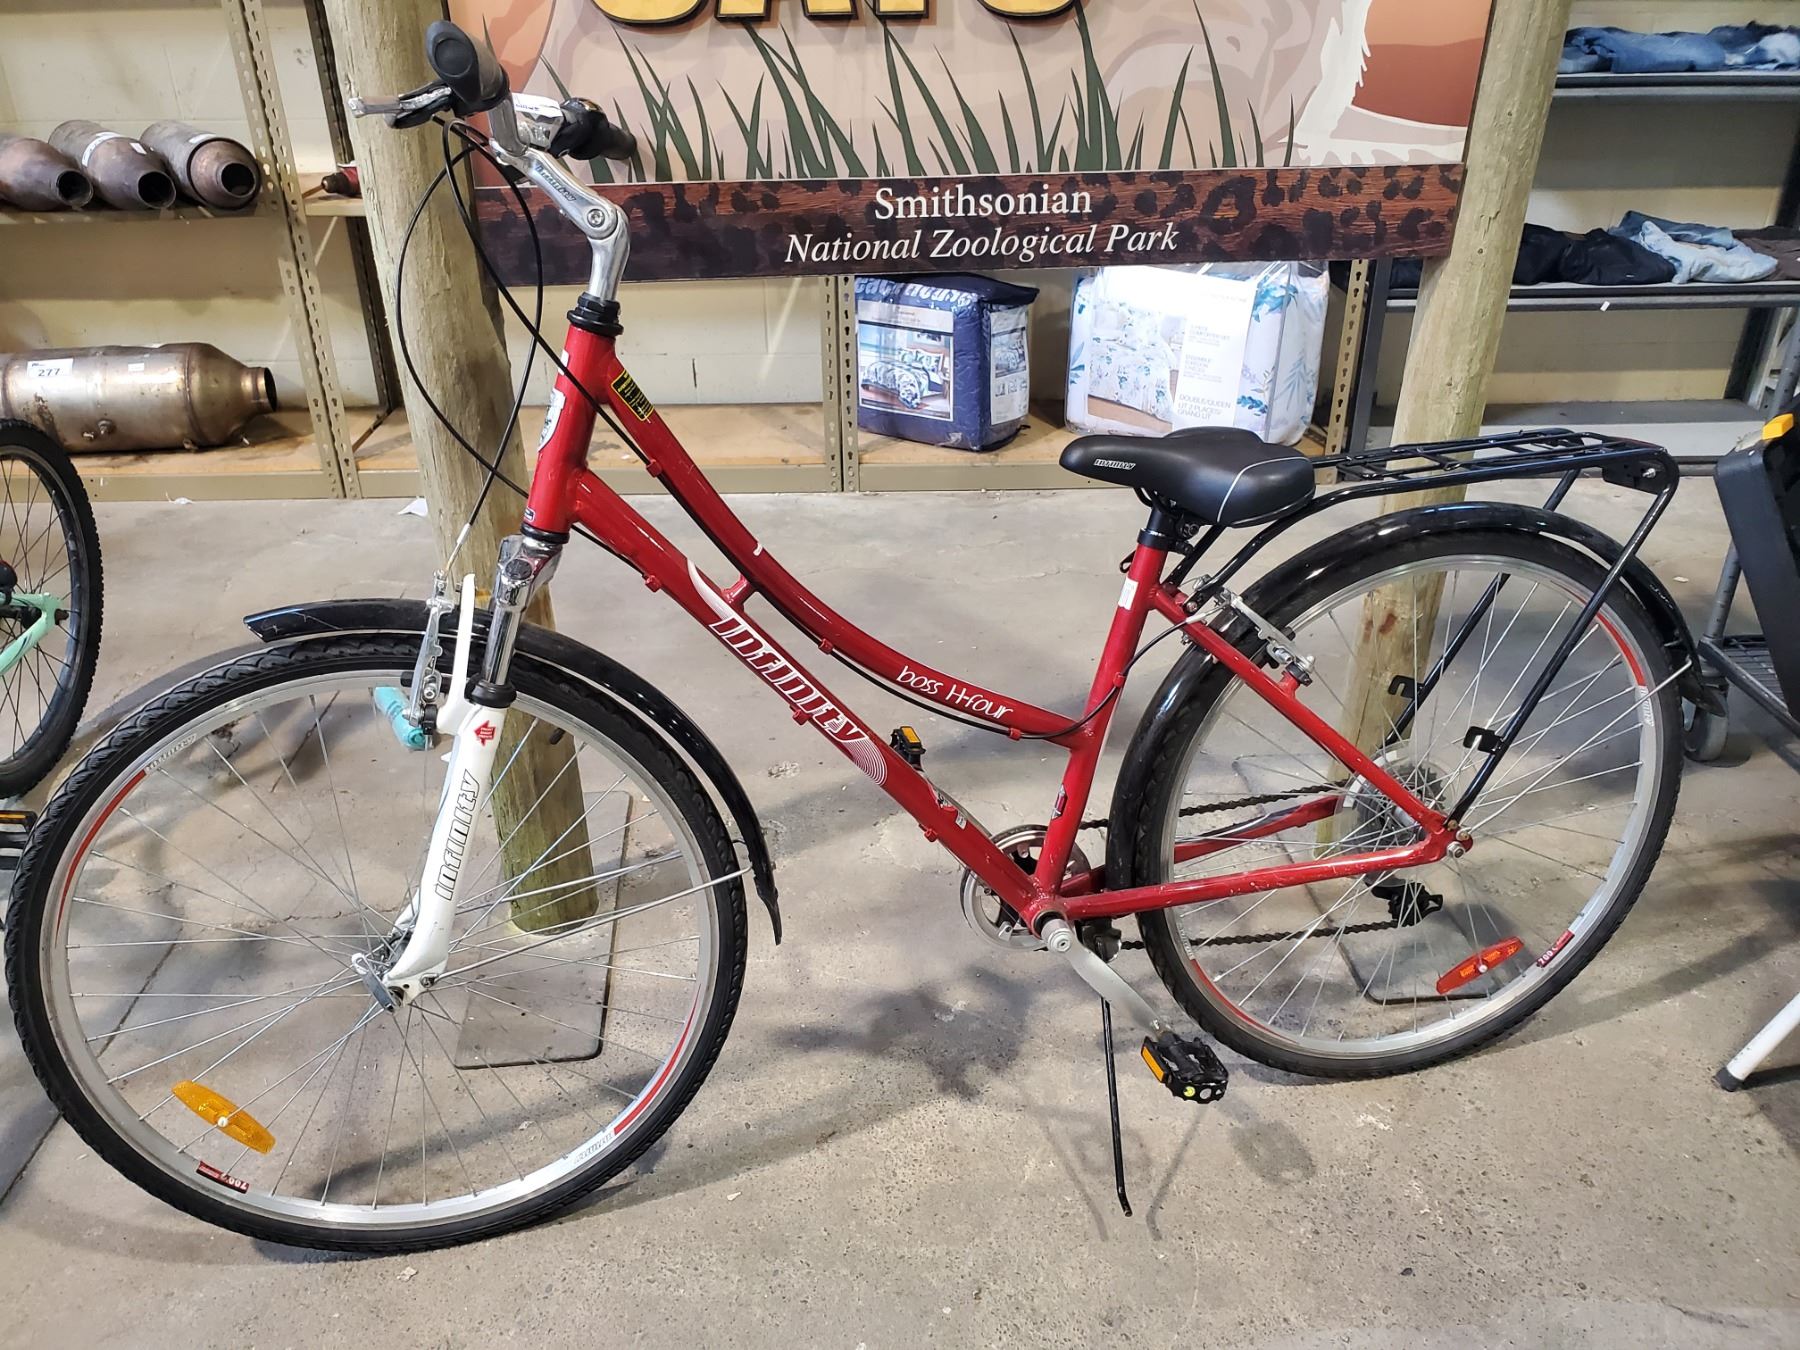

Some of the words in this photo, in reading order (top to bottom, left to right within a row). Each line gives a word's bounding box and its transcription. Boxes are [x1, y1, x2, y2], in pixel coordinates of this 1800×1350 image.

[874, 184, 1093, 220] Smithsonian
[785, 233, 921, 263] National
[930, 225, 1096, 263] Zoological
[1103, 222, 1180, 253] Park
[38, 368, 60, 377] 277
[896, 665, 943, 694] boss
